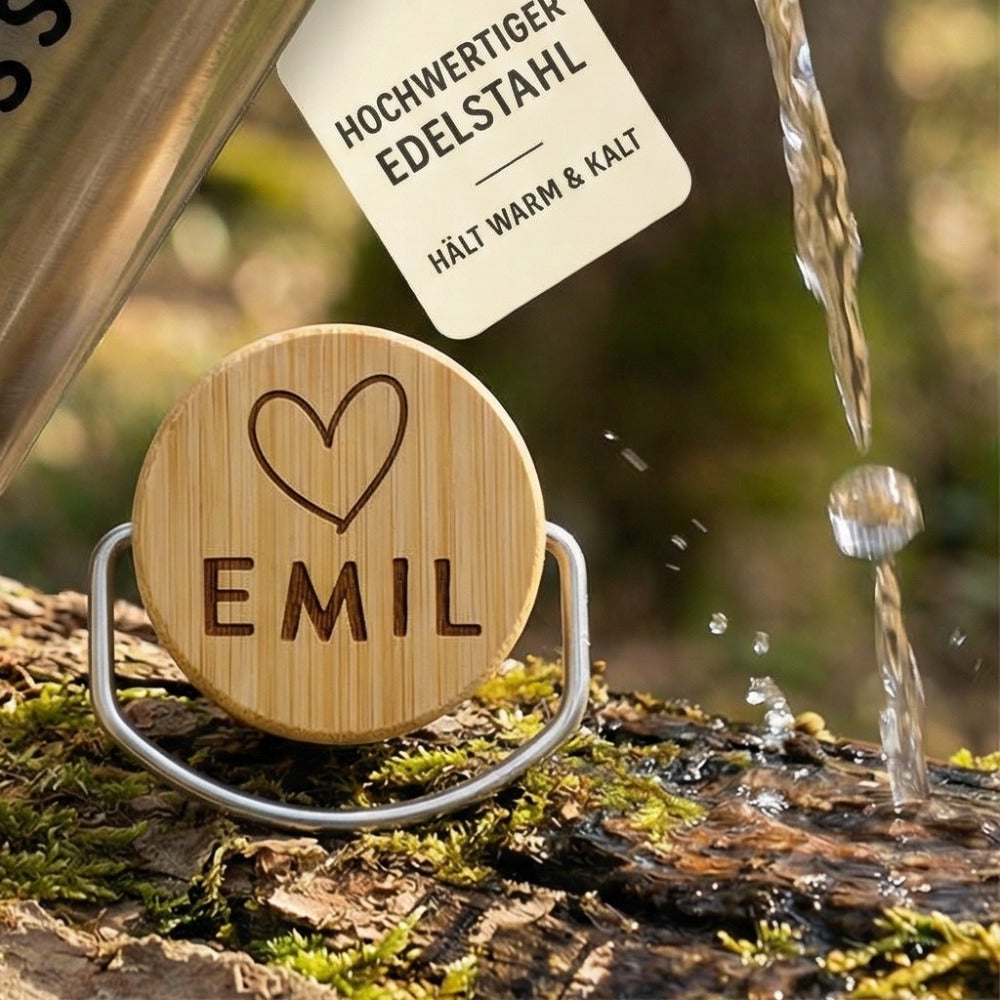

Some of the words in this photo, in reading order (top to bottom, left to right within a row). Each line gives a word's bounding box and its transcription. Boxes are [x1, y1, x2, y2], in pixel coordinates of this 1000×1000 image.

[375, 40, 588, 187] EDELSTAHL
[427, 225, 486, 275] HÄLT
[486, 178, 564, 236] WARM
[563, 166, 586, 190] &
[584, 127, 642, 177] KALT
[203, 556, 483, 643] EMIL
